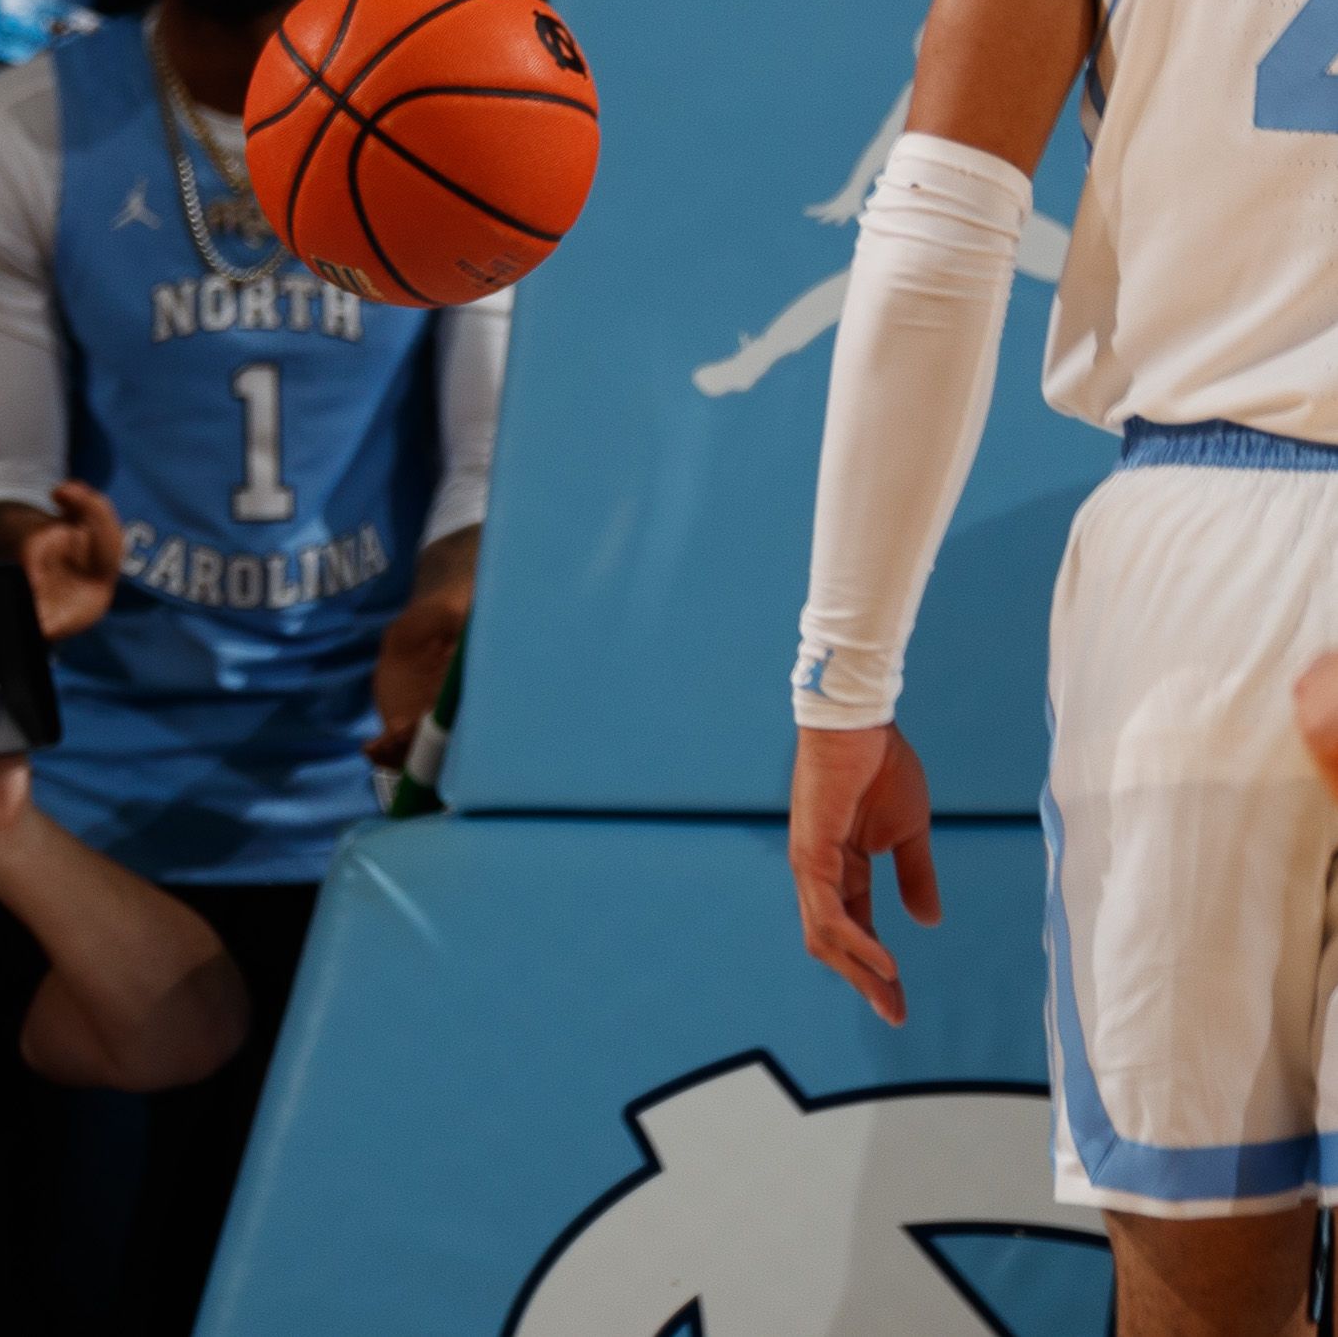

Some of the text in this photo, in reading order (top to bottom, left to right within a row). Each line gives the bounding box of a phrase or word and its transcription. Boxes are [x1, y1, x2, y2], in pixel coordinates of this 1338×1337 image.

[150, 272, 364, 344] NORTH
[231, 361, 294, 522] 1
[121, 521, 387, 609] CAROLINA
